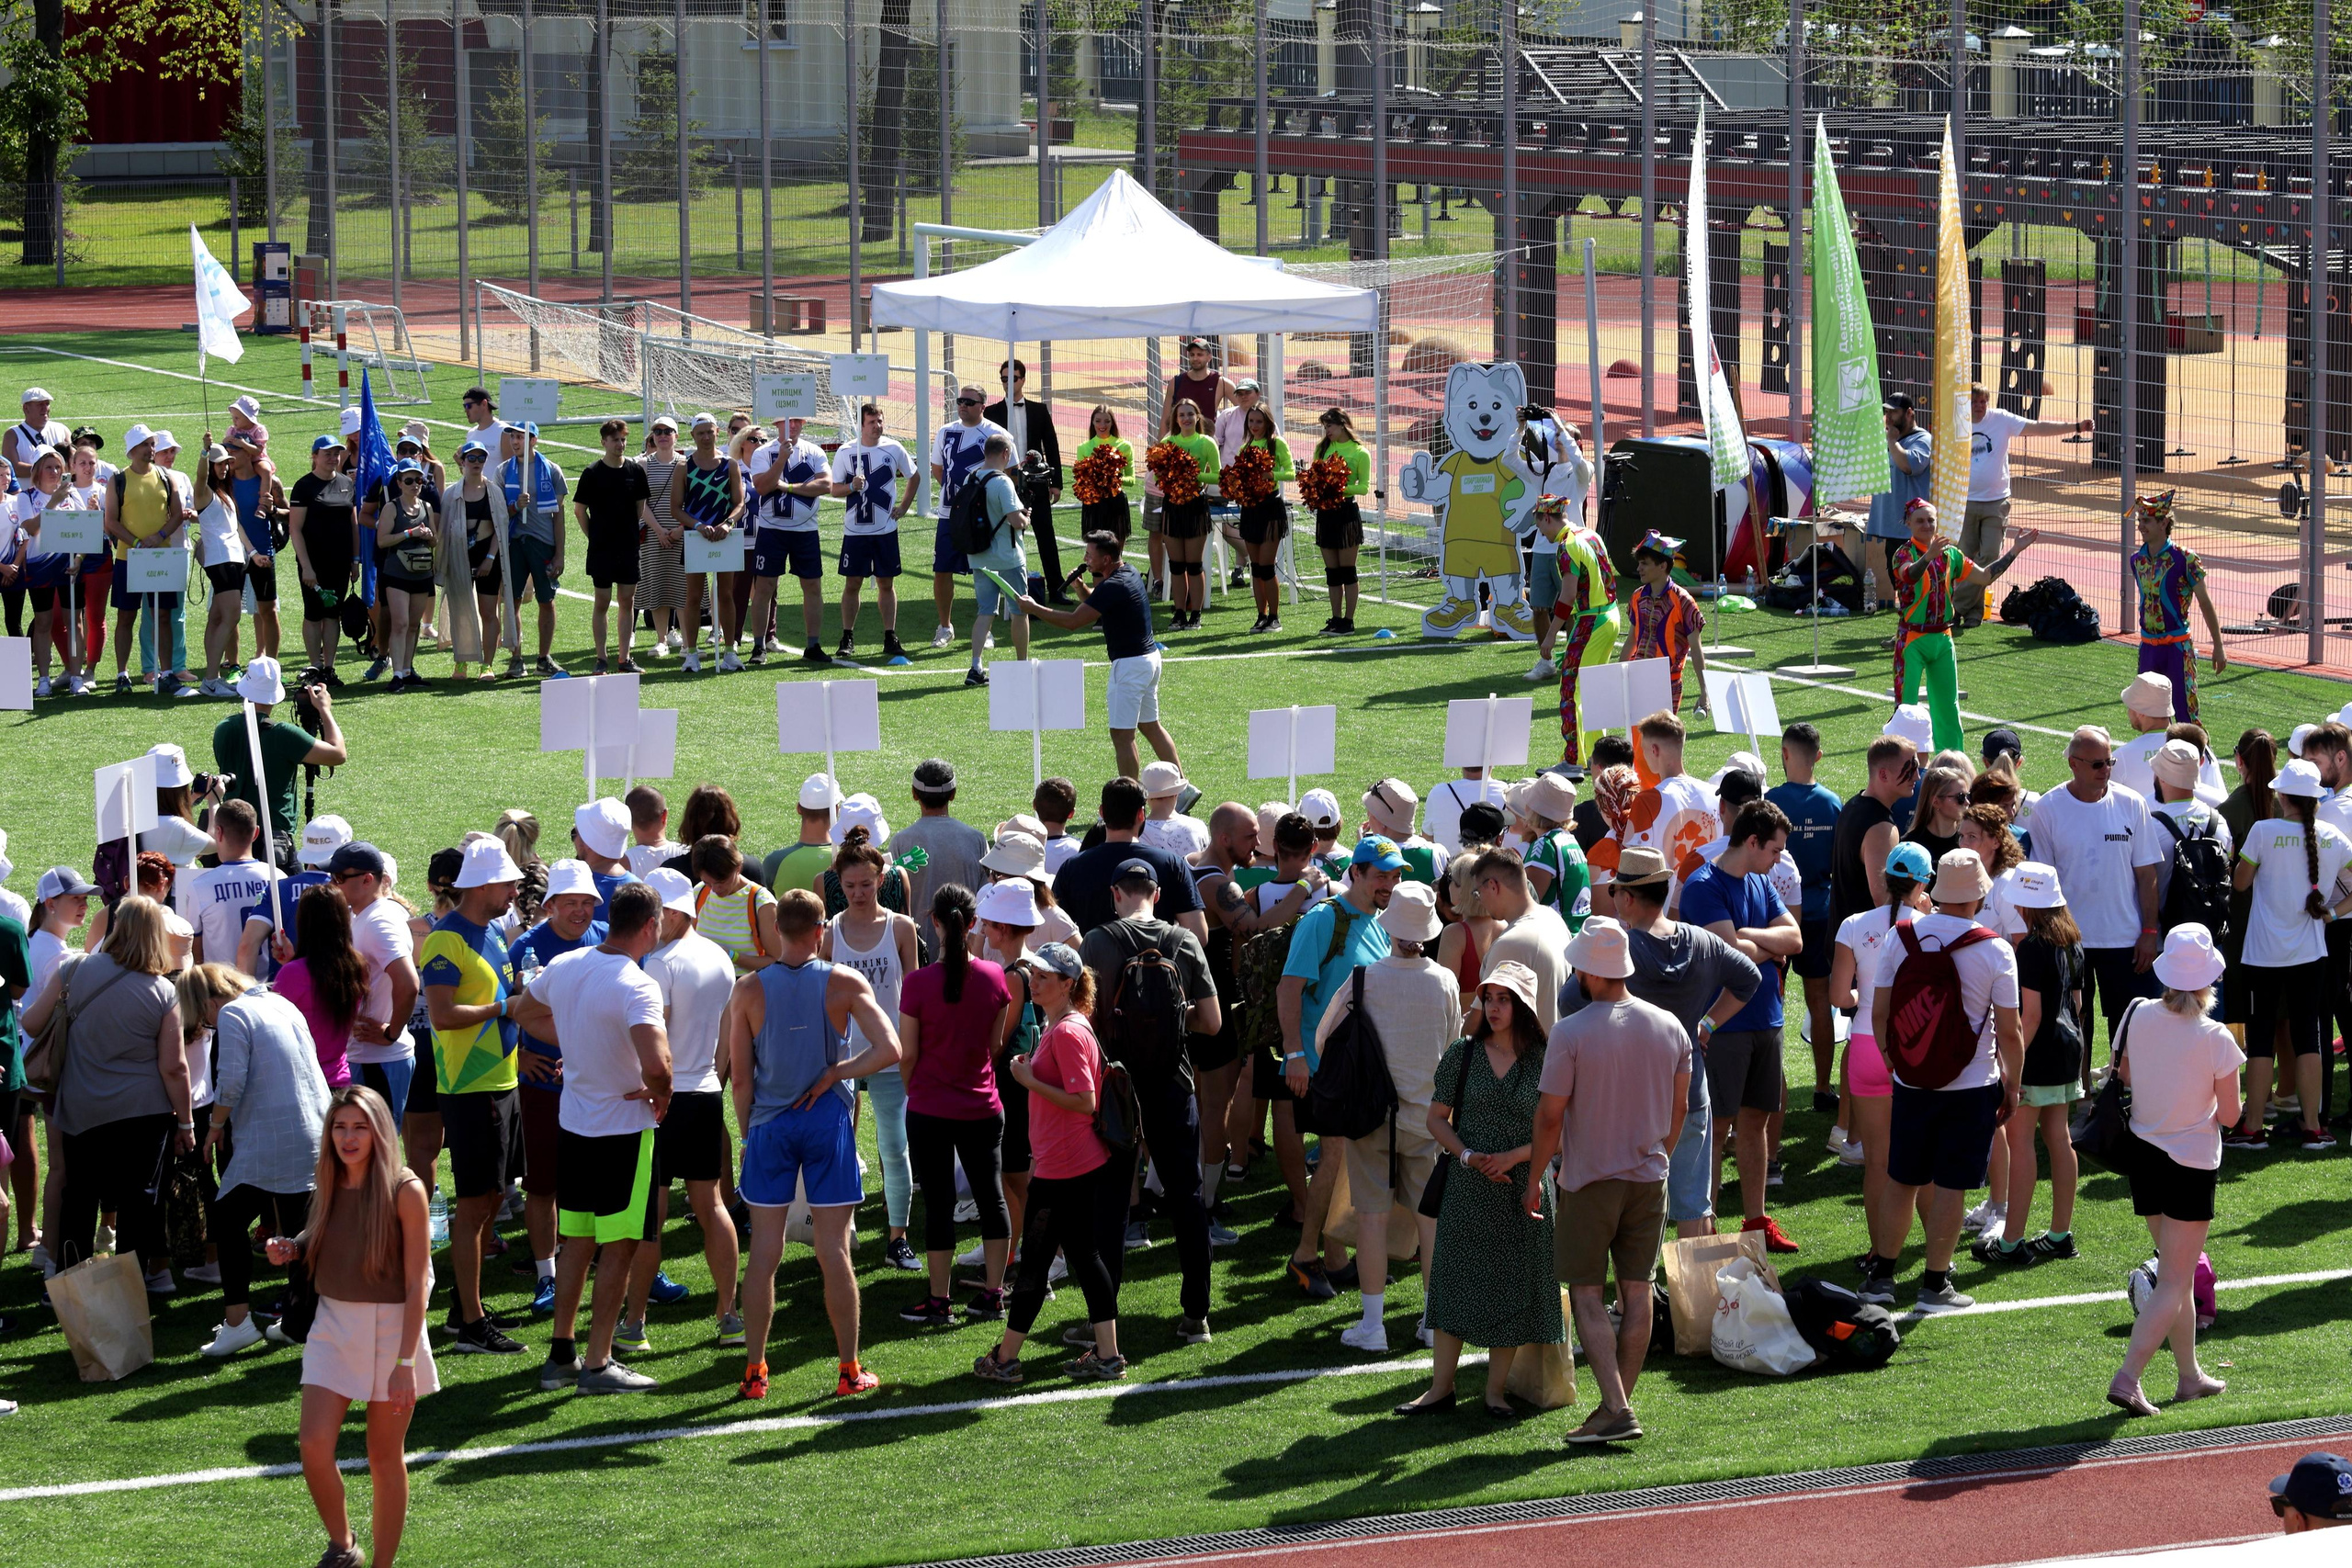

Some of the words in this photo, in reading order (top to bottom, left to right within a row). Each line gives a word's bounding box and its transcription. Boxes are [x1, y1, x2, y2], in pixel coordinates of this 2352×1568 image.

[772, 389, 802, 397] МТНПЦМК
[775, 400, 798, 409] (ЦЭМП)
[755, 554, 765, 570] 13
[842, 553, 850, 568] 6
[307, 836, 320, 845] NIKE
[2104, 833, 2129, 842] PUMA
[2273, 836, 2300, 849] ДГП
[2320, 838, 2332, 849] 86
[213, 881, 243, 903] ДГП
[432, 959, 448, 967] BLIZKO
[841, 957, 888, 969] UNNING
[1894, 986, 1940, 1044] NIKE
